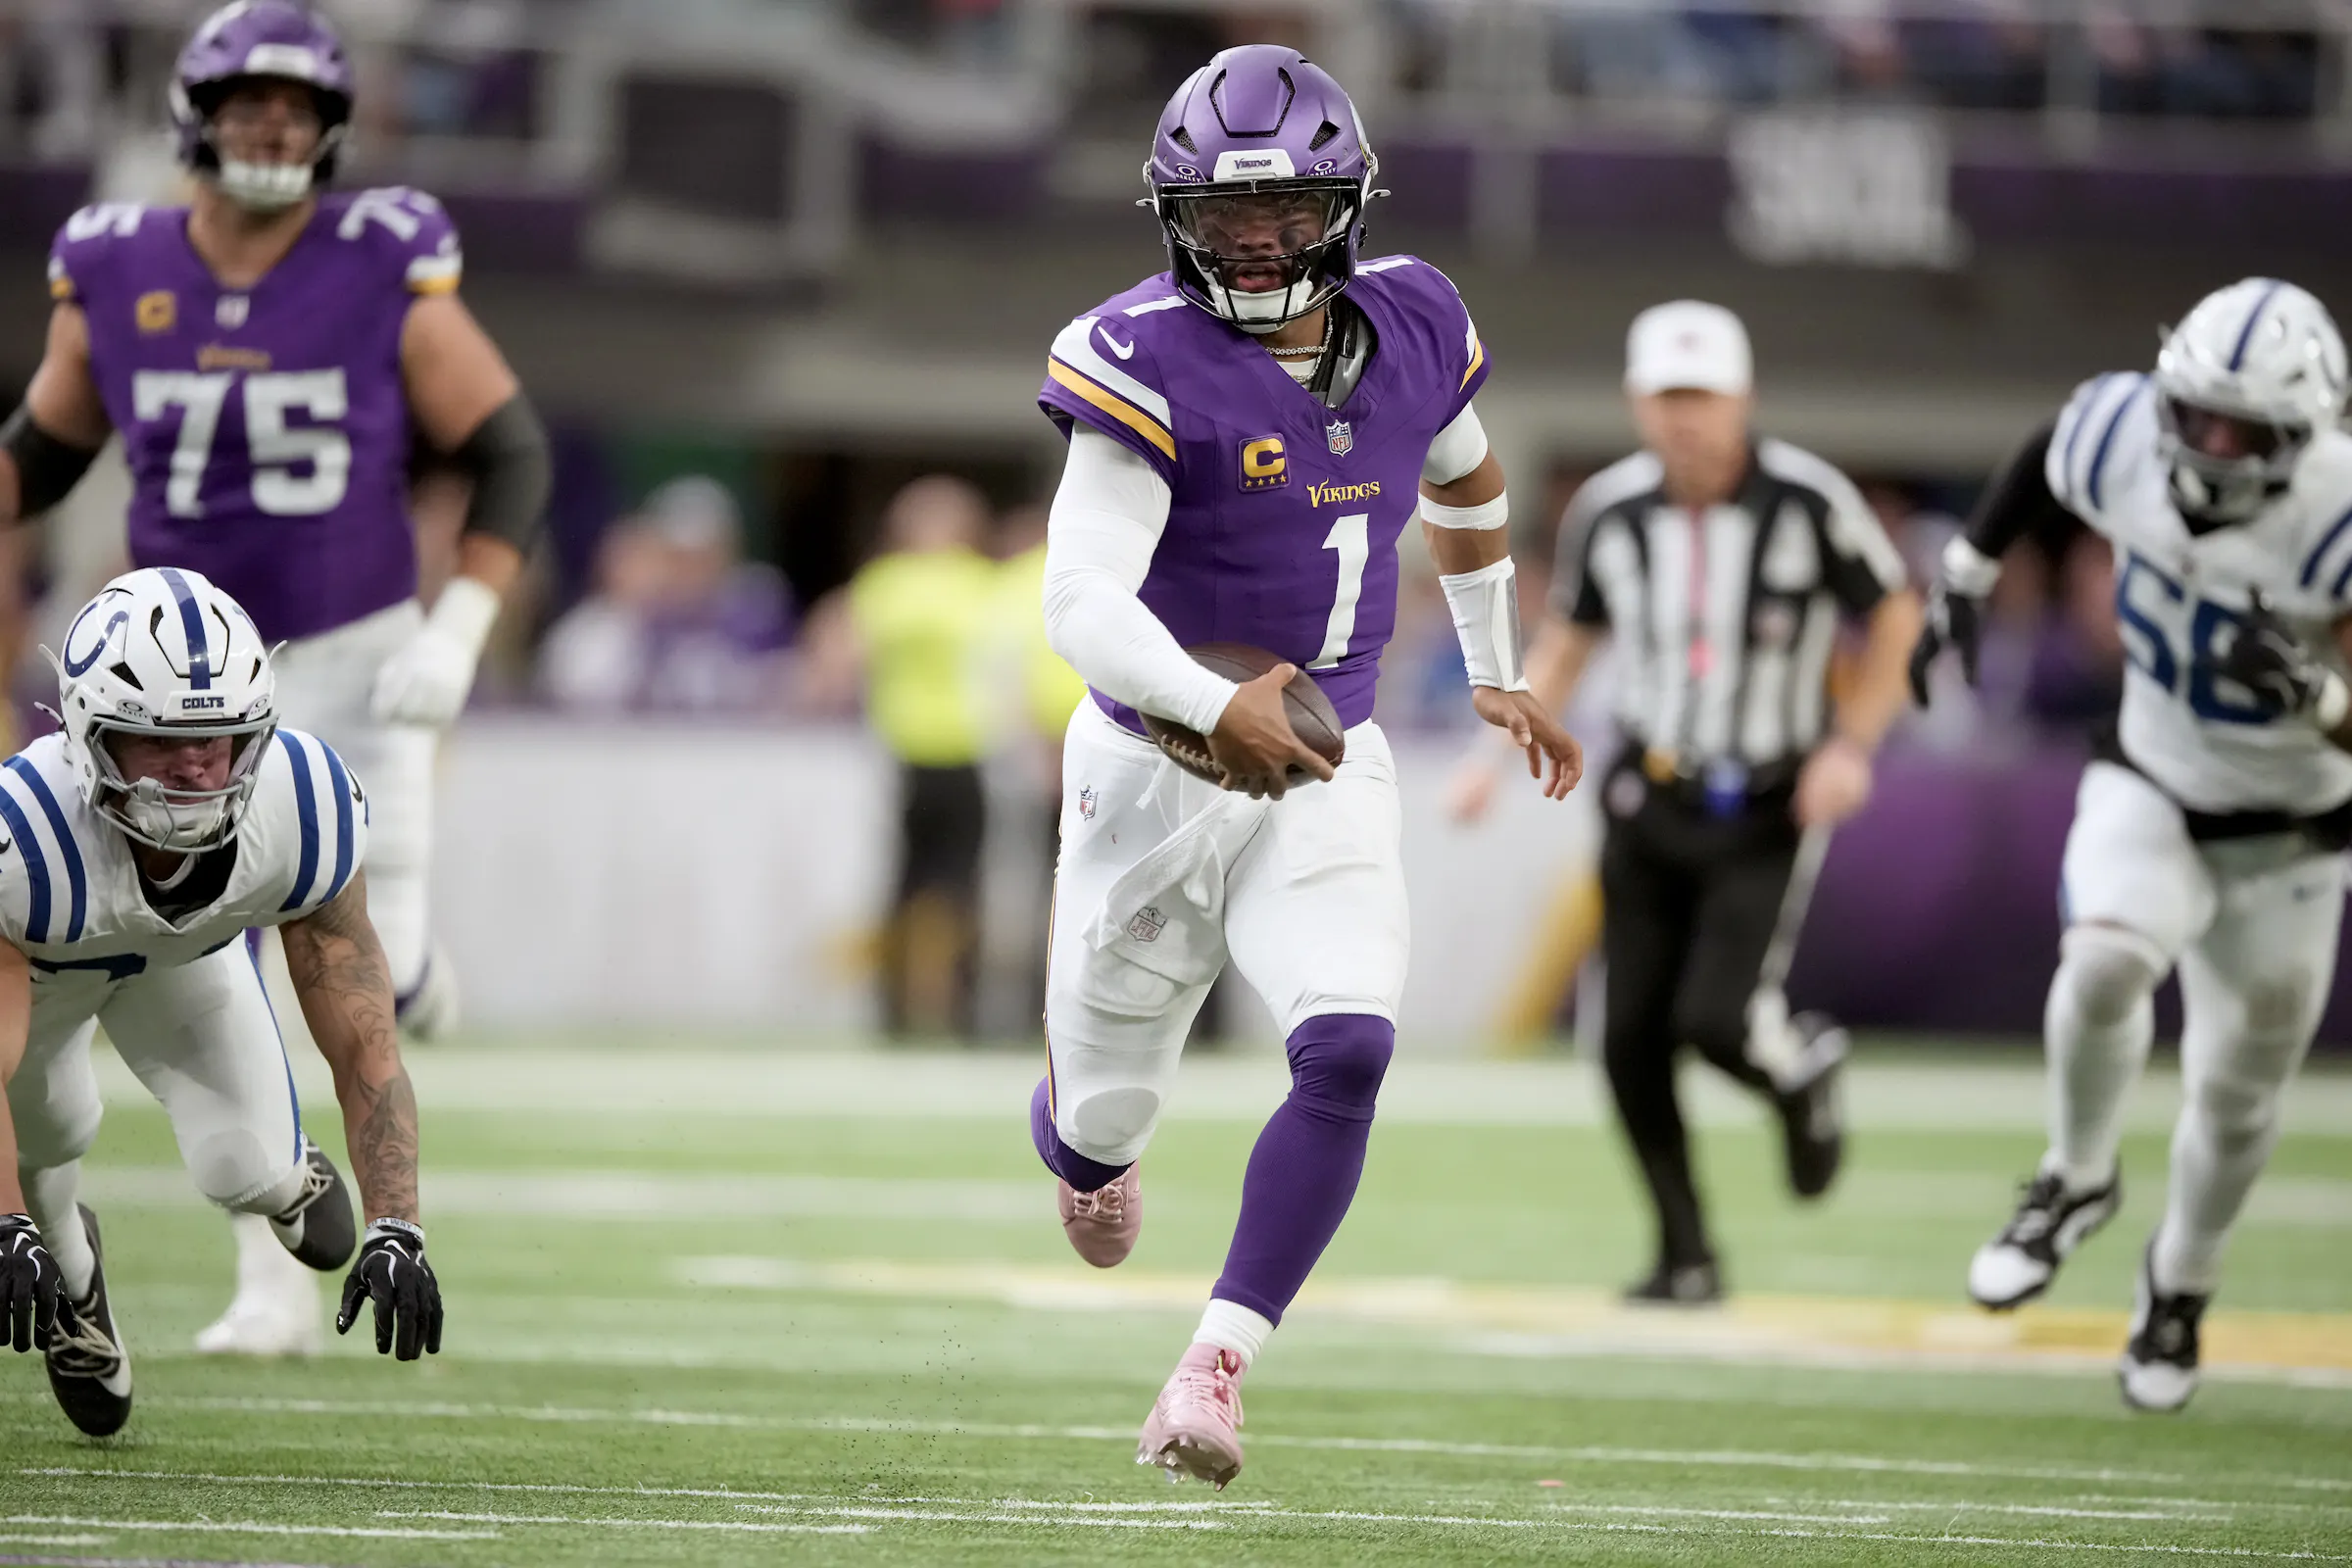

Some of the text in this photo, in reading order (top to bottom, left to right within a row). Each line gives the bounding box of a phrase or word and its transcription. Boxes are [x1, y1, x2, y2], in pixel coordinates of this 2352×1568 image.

[132, 368, 352, 521] 75
[1243, 437, 1286, 478] C
[1332, 435, 1349, 451] NFL
[1304, 513, 1369, 670] 1
[181, 696, 225, 710] COLTS
